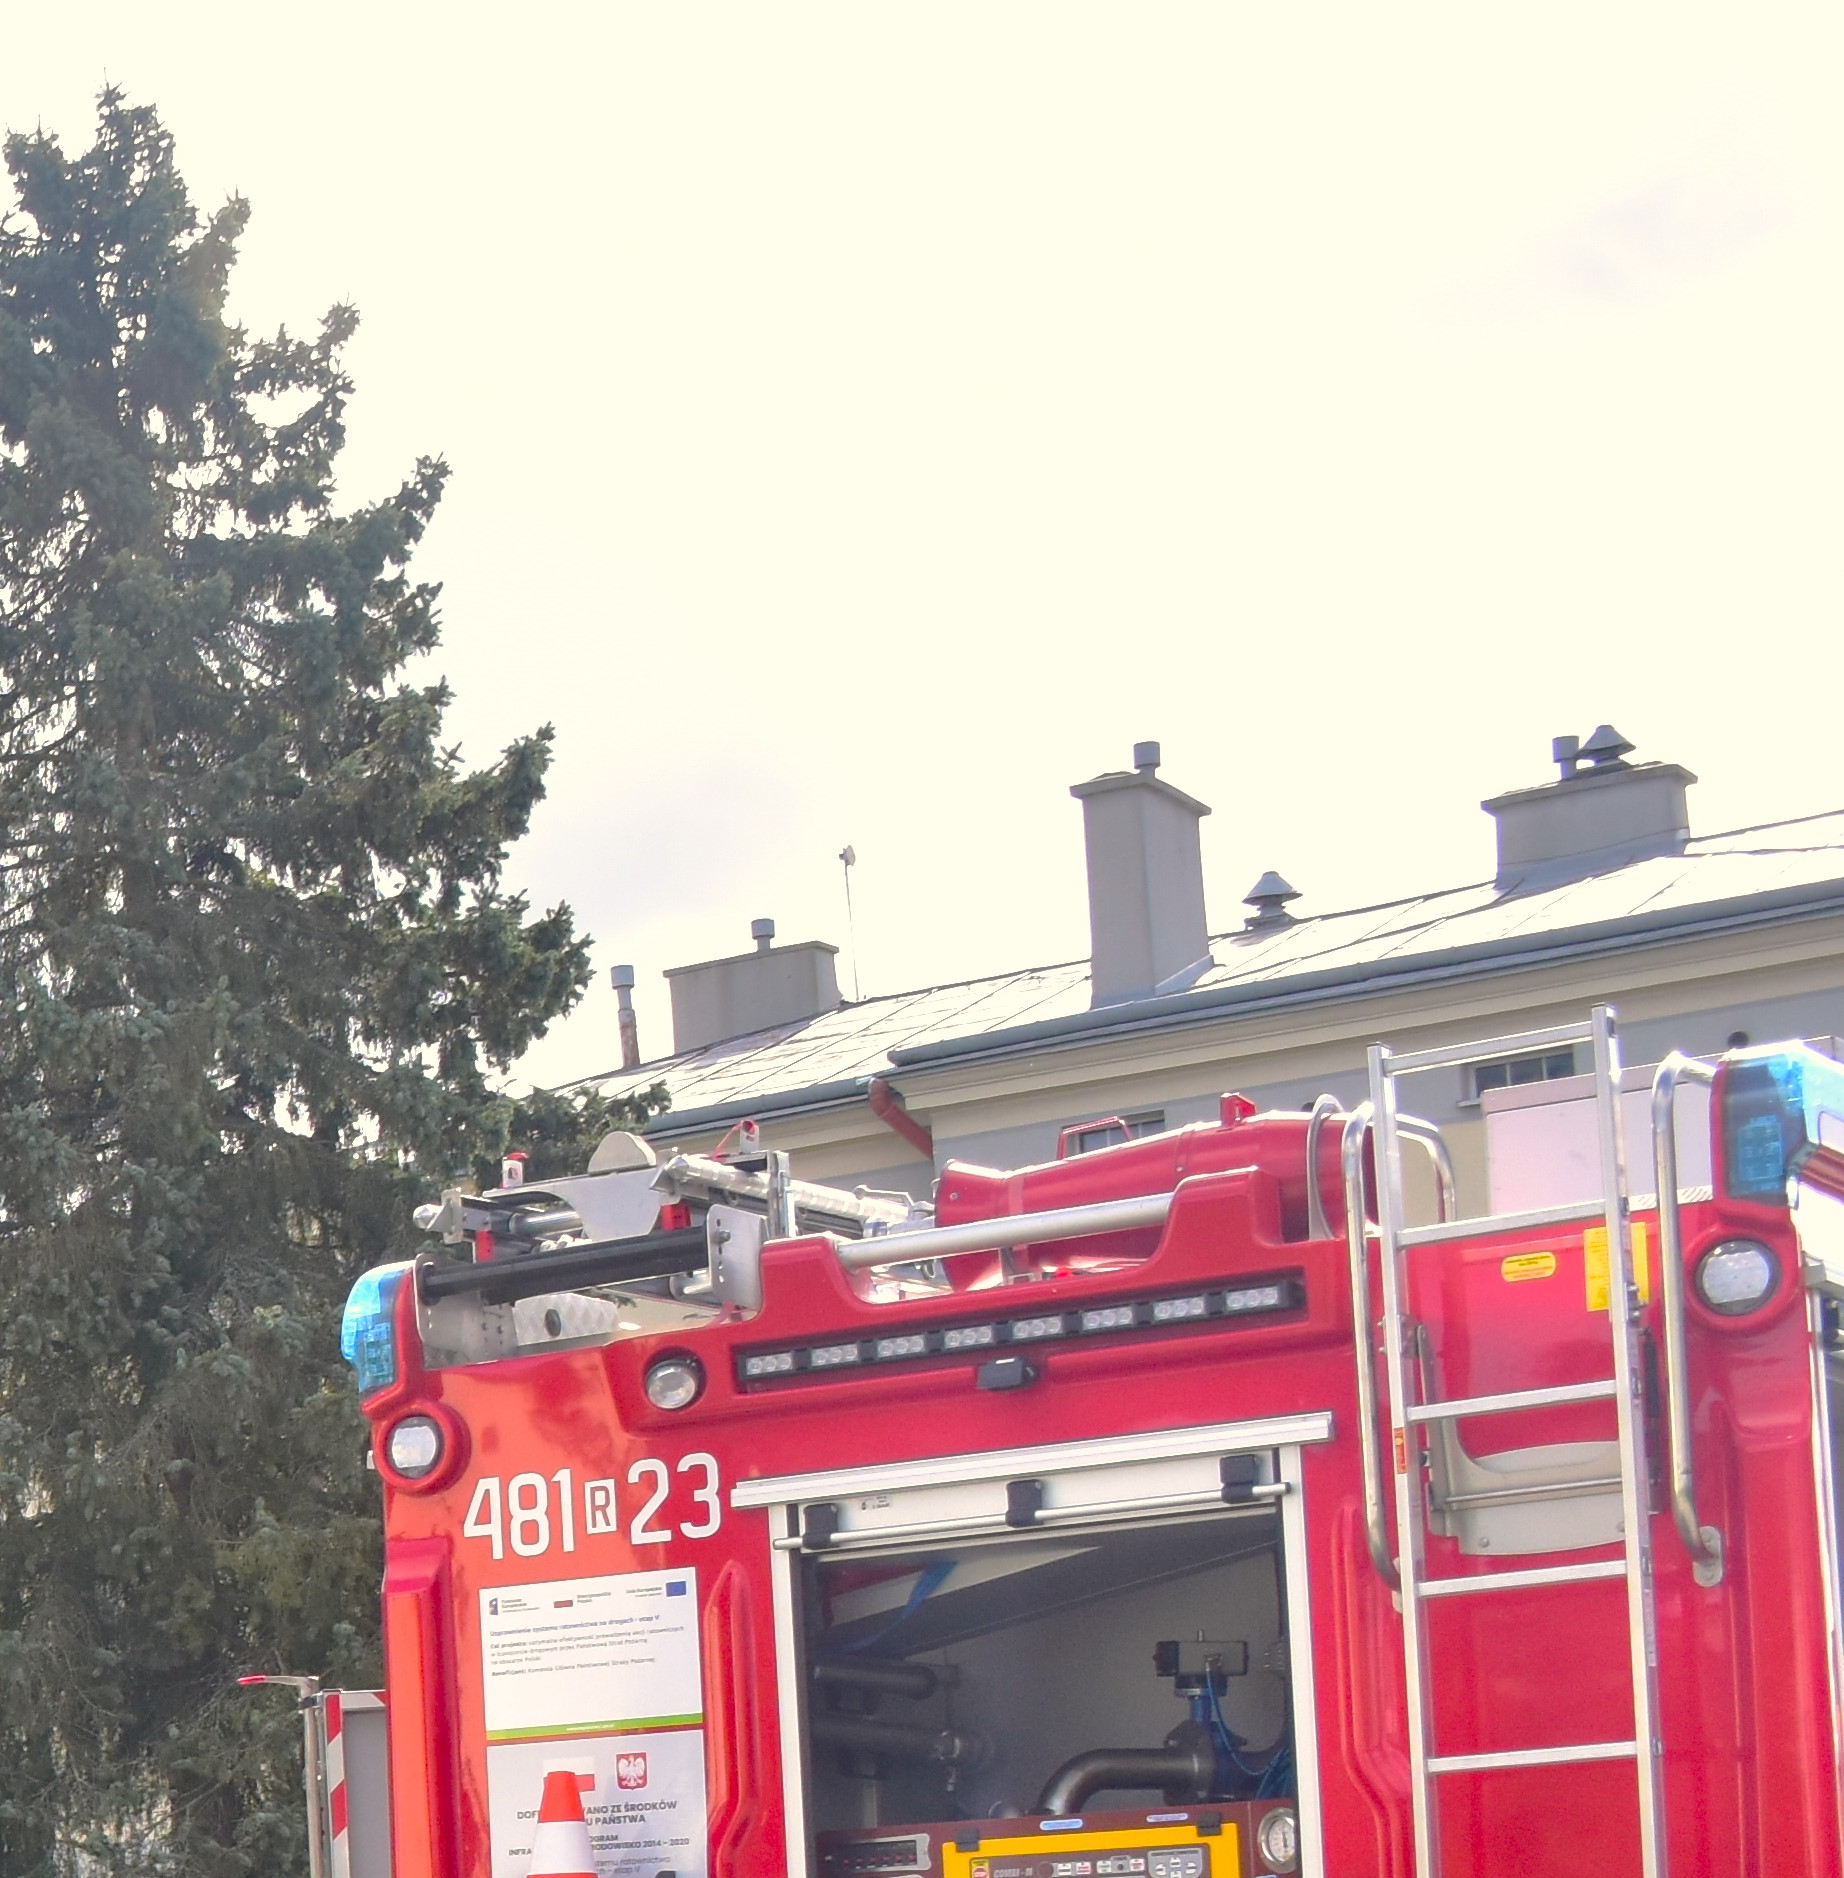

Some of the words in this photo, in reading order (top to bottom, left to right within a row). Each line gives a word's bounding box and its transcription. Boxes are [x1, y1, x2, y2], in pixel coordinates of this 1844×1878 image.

[463, 1467, 575, 1561] 481
[627, 1452, 721, 1546] 23
[508, 1848, 532, 1856] INFRA
